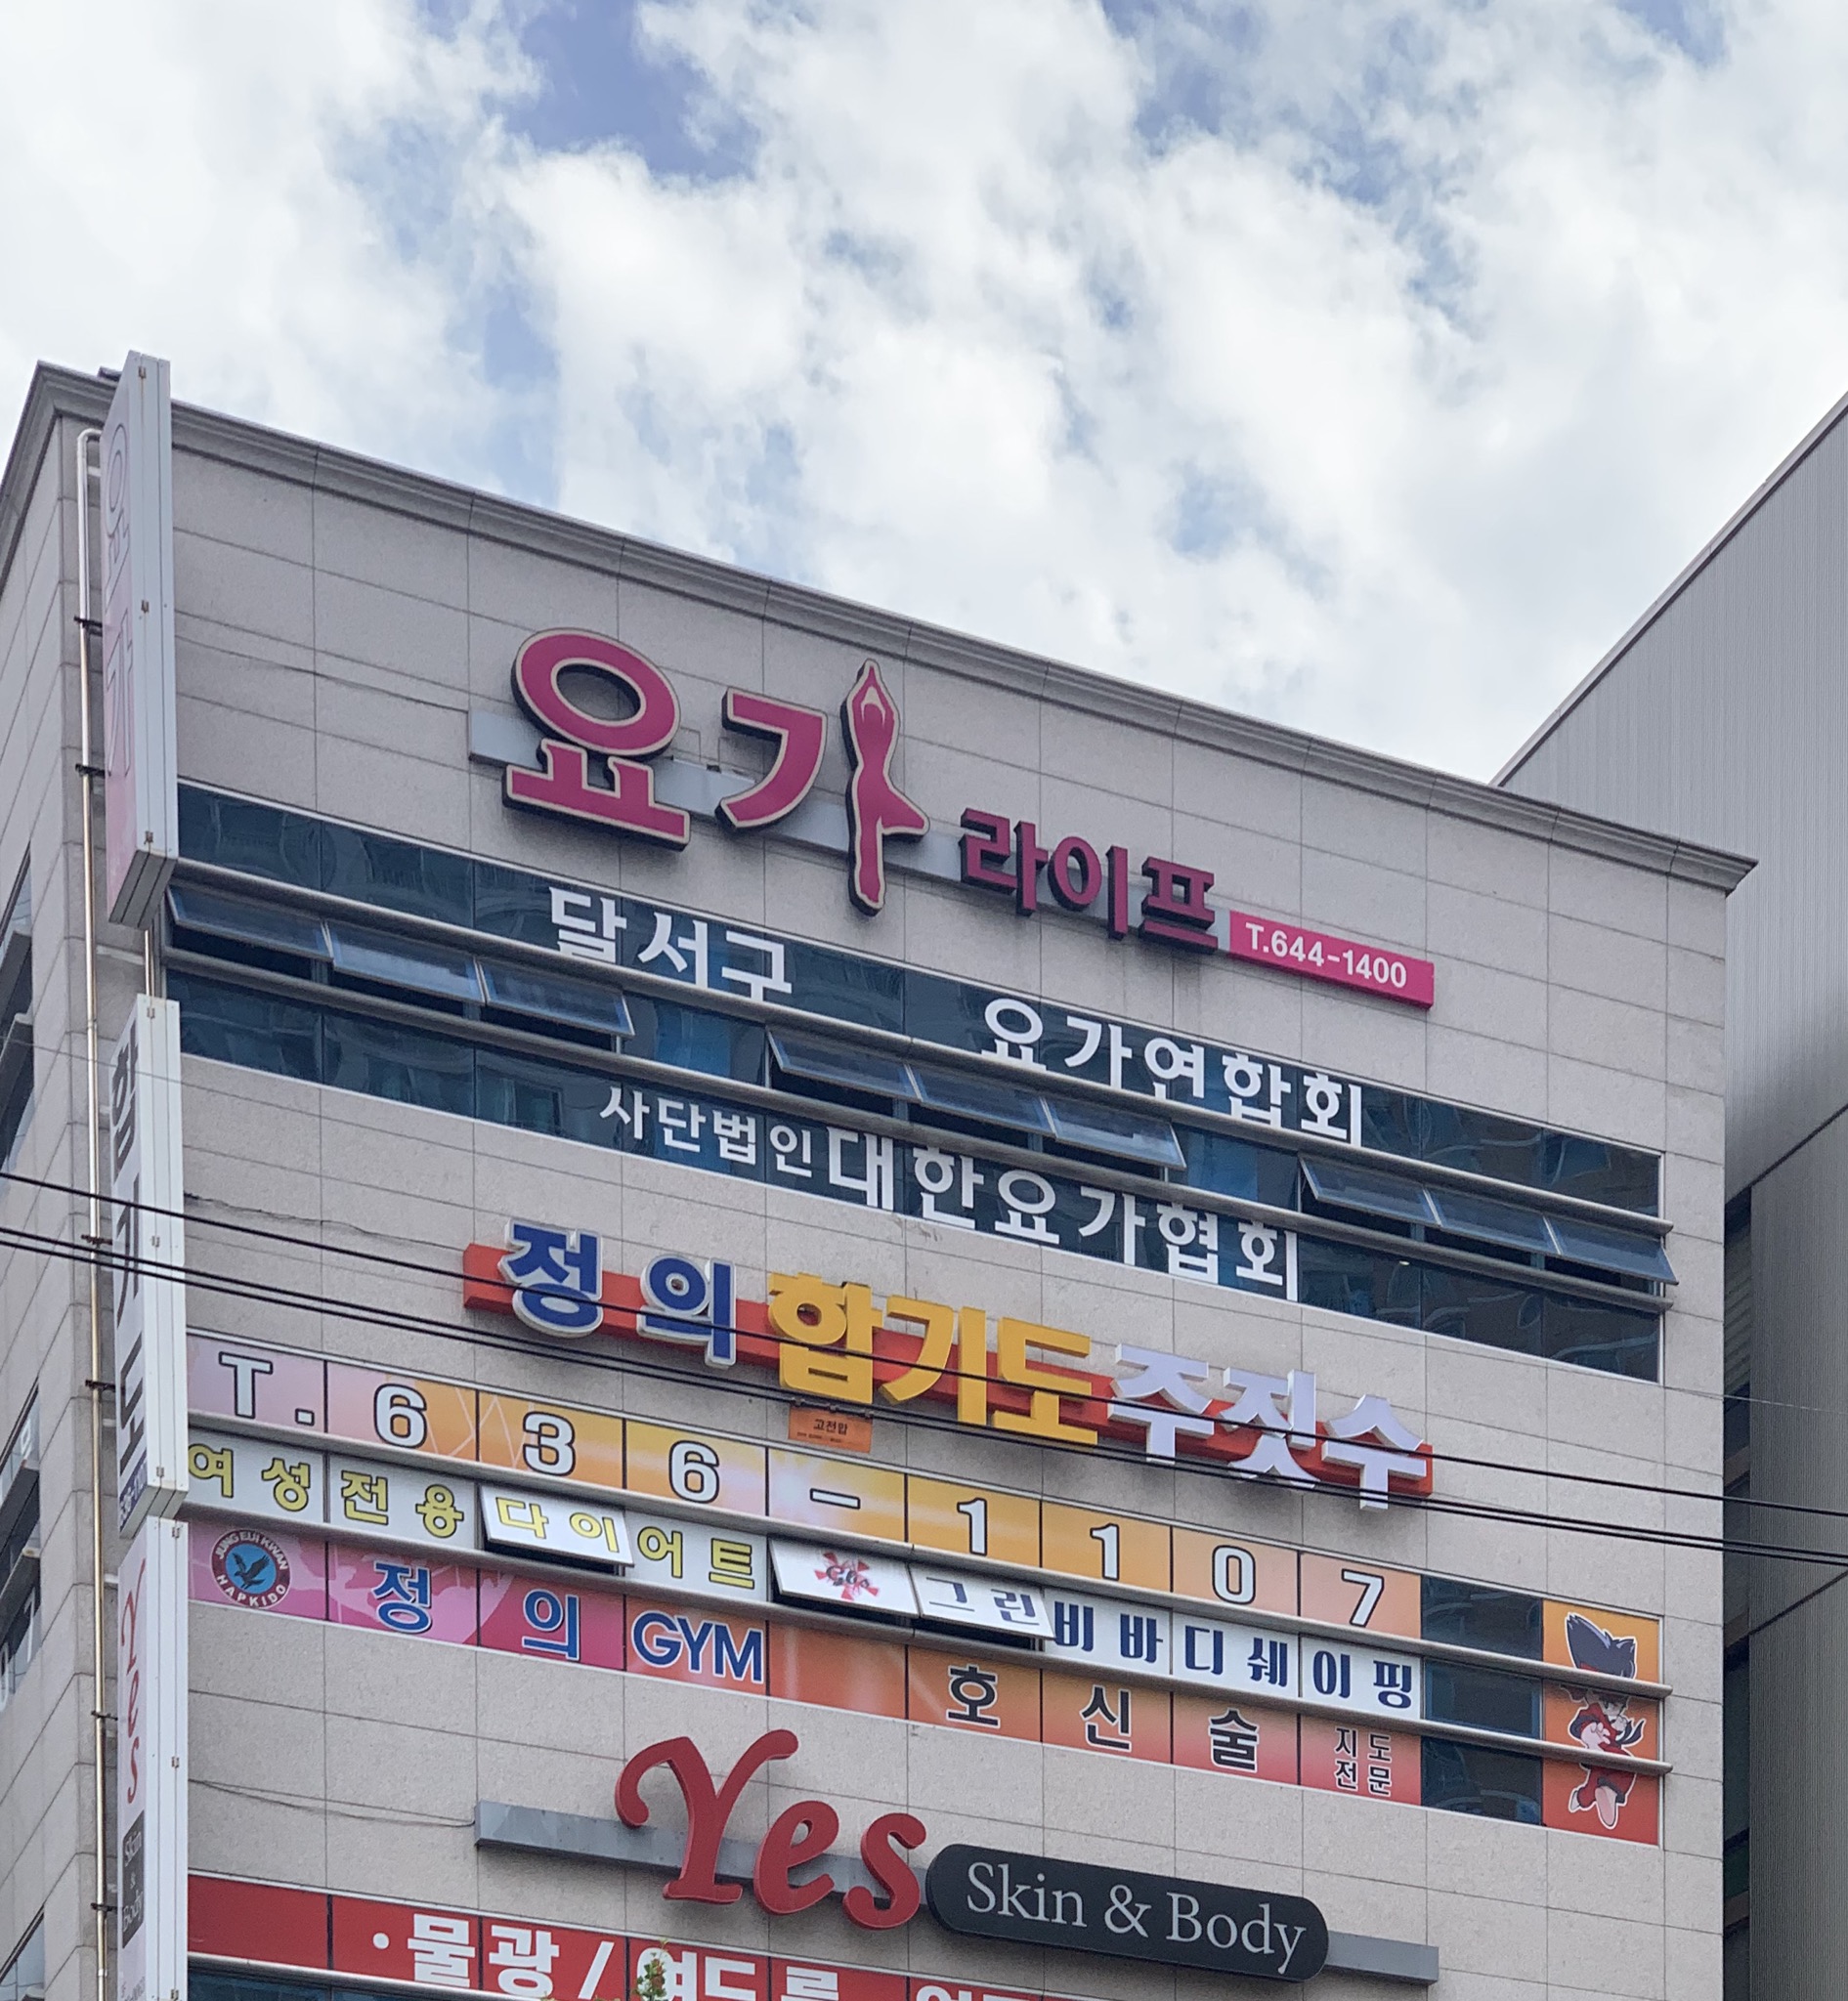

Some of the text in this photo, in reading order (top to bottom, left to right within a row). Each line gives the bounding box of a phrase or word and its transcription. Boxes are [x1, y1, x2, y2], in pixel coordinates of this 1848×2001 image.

[502, 627, 929, 916] 요가
[959, 807, 1219, 954] 라이프
[1245, 922, 1408, 989] T.644-1400
[548, 886, 1362, 1148] 달서구 요가연합회
[111, 1018, 145, 1476] 합기도
[599, 1086, 1300, 1301] 사단법인 대한요가협회
[497, 1217, 1428, 1511] 정의 합기도 주짓수
[217, 1574, 287, 1607] HAPKIDO
[370, 1560, 766, 1685] 정의 GYM
[495, 1495, 756, 1591] 다이어트
[121, 1557, 148, 1805] Yes
[945, 1663, 1261, 1773] 호신술
[614, 1728, 1308, 1975] Yes Skin & Body
